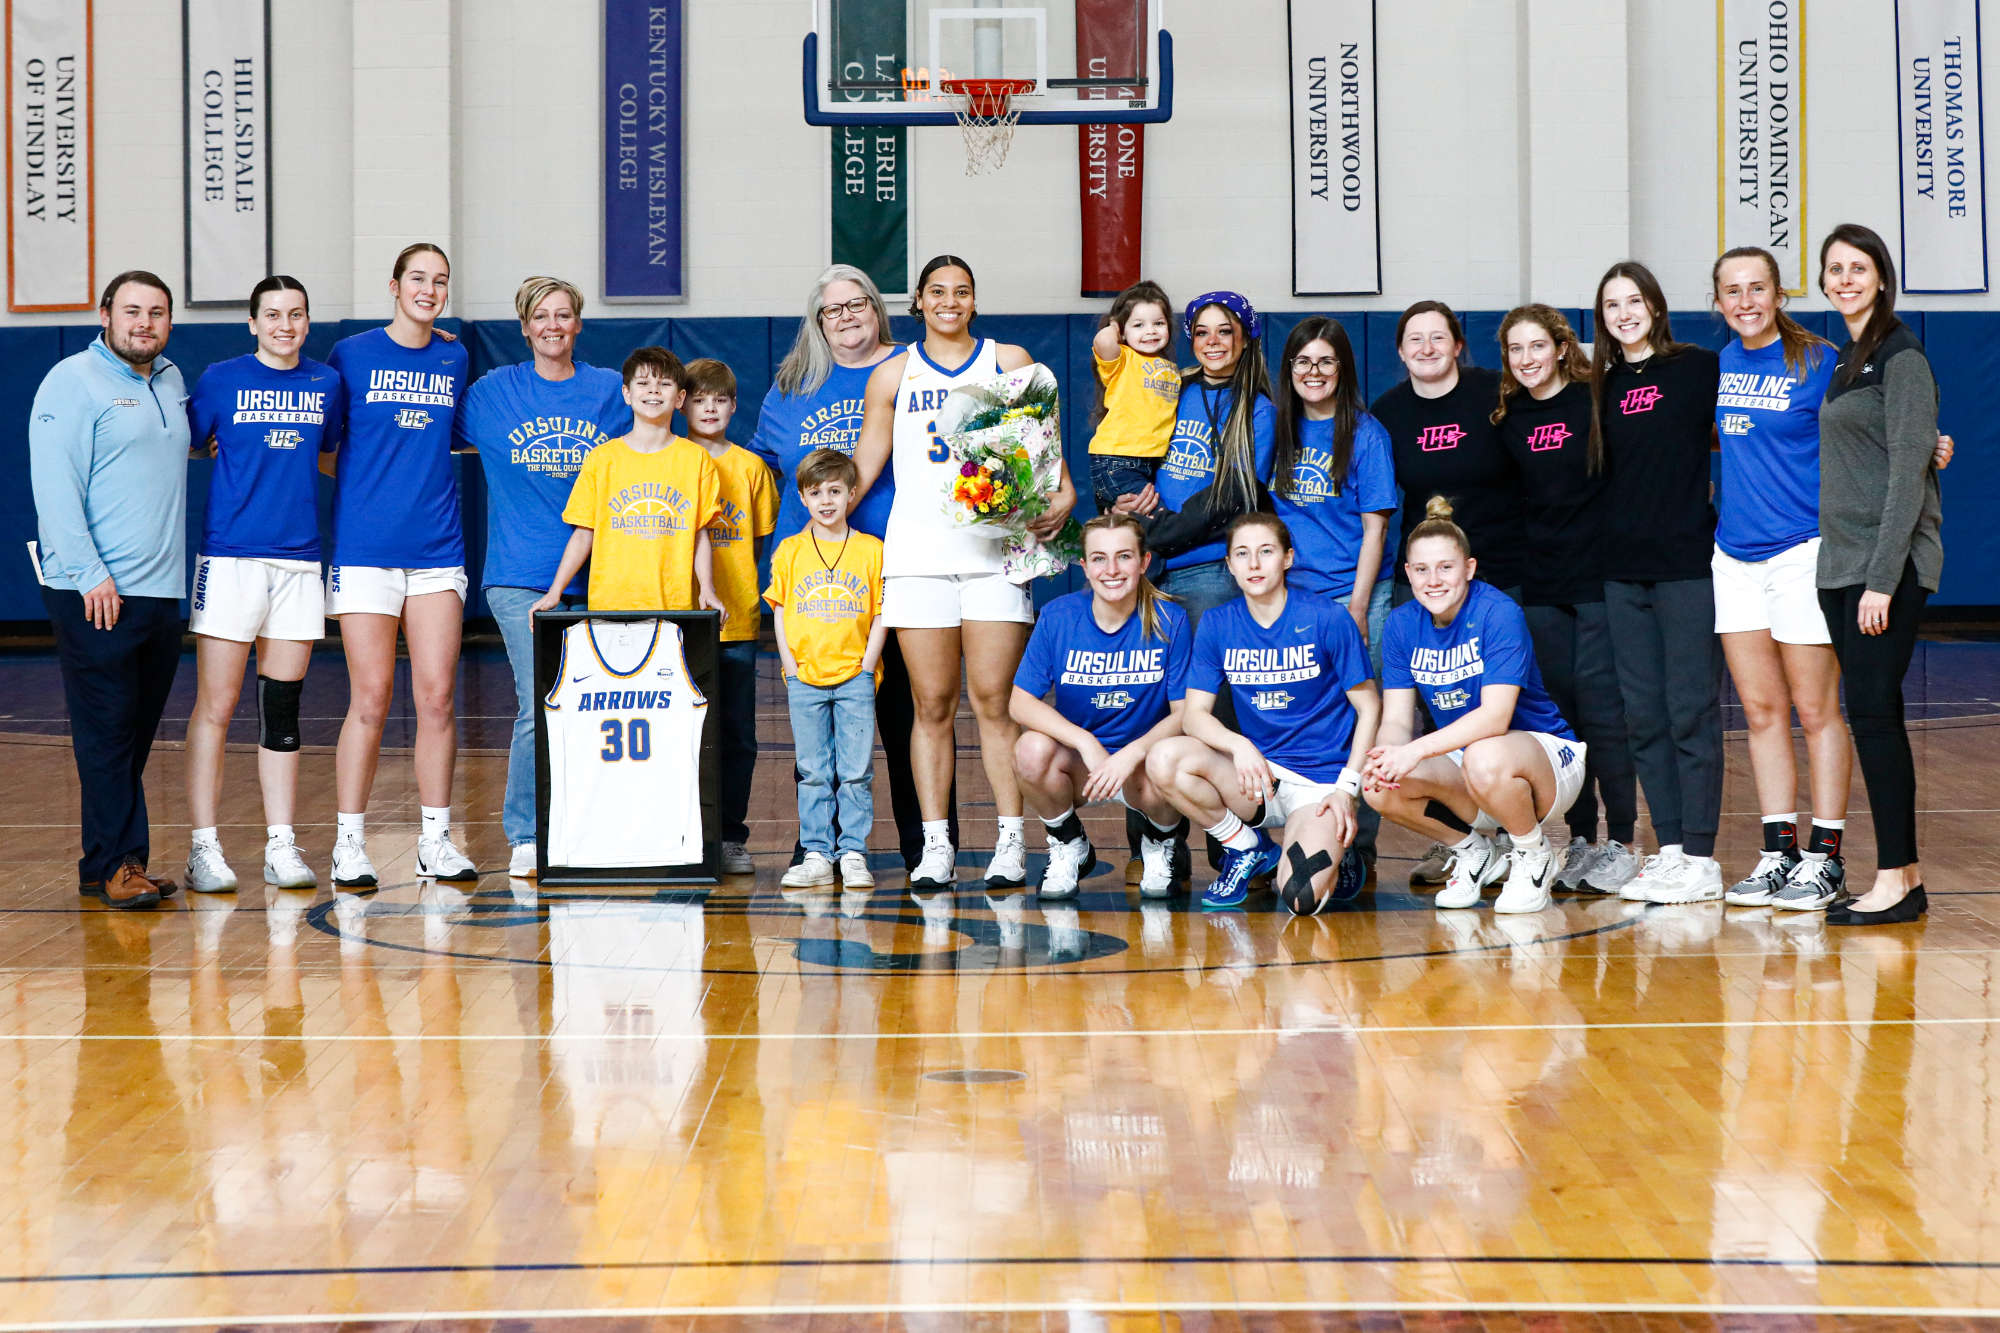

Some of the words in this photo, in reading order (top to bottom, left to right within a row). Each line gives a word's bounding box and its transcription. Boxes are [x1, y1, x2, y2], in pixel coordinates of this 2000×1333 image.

[1768, 0, 1788, 74] OHIO
[26, 58, 46, 95] OF
[648, 6, 667, 137] KENTUCKY
[1943, 36, 1964, 140] THOMAS
[56, 54, 76, 224] UNIVERSITY
[203, 69, 224, 202] COLLEGE
[233, 57, 255, 213] HILLSDALE
[619, 82, 638, 191] COLLEGE
[1308, 55, 1329, 202] UNIVERSITY
[1340, 42, 1361, 212] NORTHWOOD
[1738, 38, 1759, 210] UNIVERSITY
[1912, 56, 1934, 200] UNIVERSITY
[26, 103, 46, 223] FINDLAY
[875, 135, 896, 202] ERIE
[1769, 81, 1789, 250] DOMINICAN
[1946, 147, 1966, 219] MORE
[648, 141, 667, 267] WESLEYAN
[369, 369, 455, 396] URSULINE
[237, 389, 326, 413] URSULINE
[372, 391, 455, 408] BASKETBALL
[239, 412, 323, 425] BASKETBALL
[398, 409, 429, 430] UC
[507, 416, 609, 446] URSULINE
[1725, 414, 1751, 436] UC
[268, 429, 299, 450] UC
[830, 442, 850, 450] FINAL
[526, 464, 540, 472] THE
[541, 464, 562, 472] FINAL
[608, 482, 692, 516] URSULINE
[611, 515, 689, 530] BASKETBALL
[793, 569, 869, 599] URSULINE
[796, 600, 866, 614] BASKETBALL
[1065, 648, 1164, 674] URSULINE
[1223, 643, 1317, 672] URSULINE
[1067, 673, 1158, 685] BASKETBALL
[1227, 669, 1314, 684] BASKETBALL
[577, 690, 673, 712] ARROWS
[1096, 691, 1129, 710] UC
[1256, 690, 1289, 711] UC
[599, 716, 652, 764] 30
